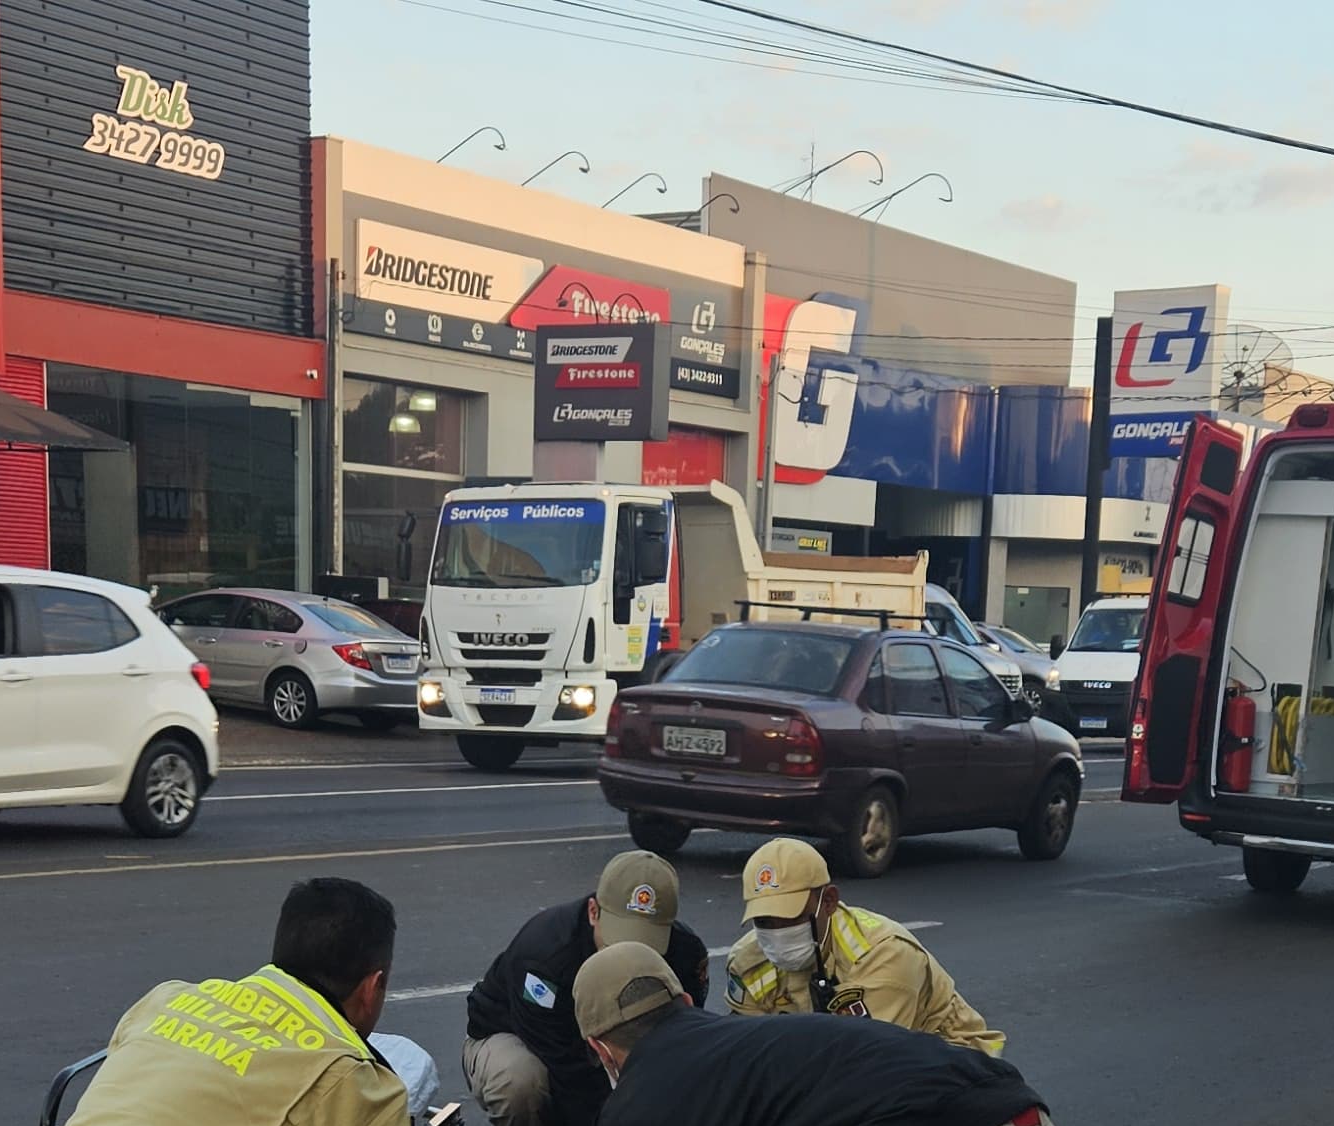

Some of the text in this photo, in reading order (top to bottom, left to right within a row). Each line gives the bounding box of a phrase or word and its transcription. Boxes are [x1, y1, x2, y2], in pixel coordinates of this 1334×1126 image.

[119, 69, 189, 126] Disk
[92, 118, 222, 174] 3427 9999
[364, 245, 494, 300] BRIDGESTONE
[550, 344, 619, 357] BRIDGESTONE
[680, 336, 726, 357] GONÇALES
[568, 367, 636, 382] Firestone
[571, 407, 633, 422] GONÇALES
[1112, 421, 1191, 440] GONÇAL
[450, 505, 585, 521] Serviços Públicos
[472, 633, 530, 647] IVECO
[1082, 681, 1112, 689] IVECO
[166, 993, 282, 1050] MILITAR
[197, 979, 325, 1050] OMBEIRO
[144, 1014, 259, 1077] PARANÁ
